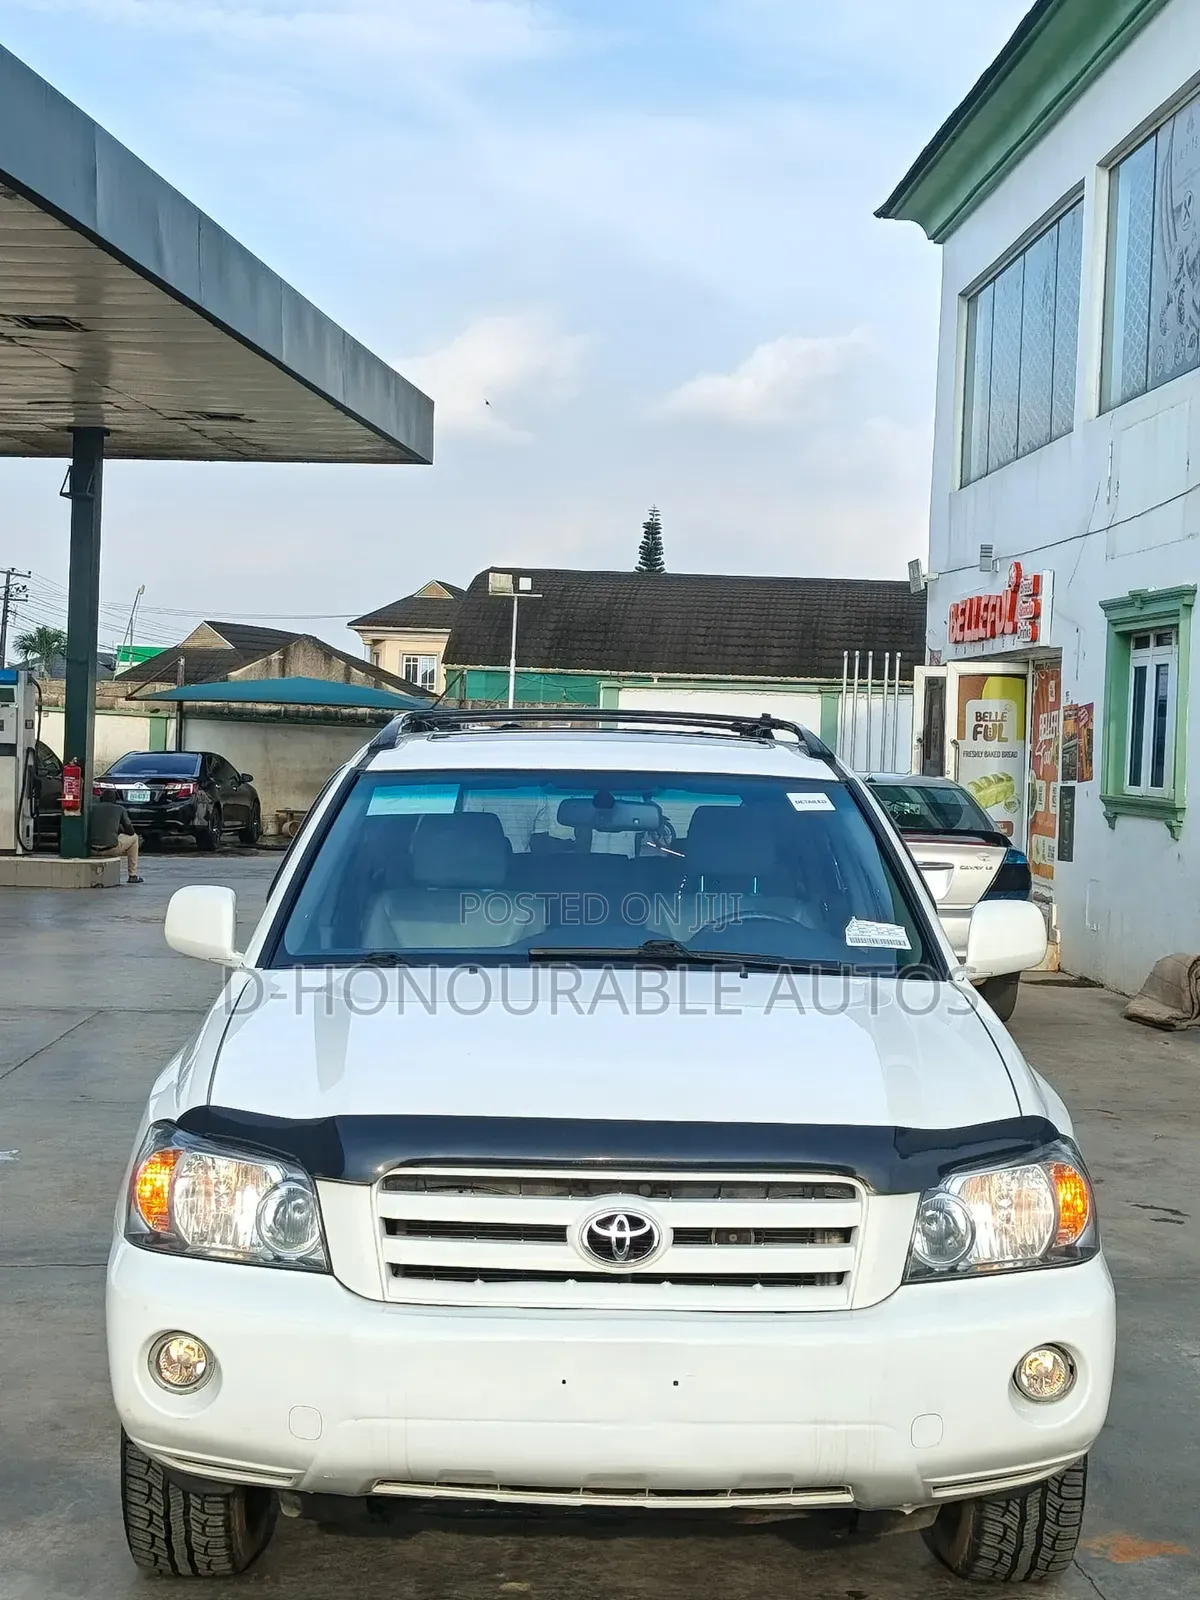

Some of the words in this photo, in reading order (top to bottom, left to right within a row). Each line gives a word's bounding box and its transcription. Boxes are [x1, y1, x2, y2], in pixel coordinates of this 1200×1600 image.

[949, 589, 1017, 643] BELLEFUL
[975, 711, 1007, 722] BELLE
[972, 723, 1009, 742] FUL
[962, 750, 983, 758] FRESHLY
[984, 750, 1001, 758] BAKED
[1002, 750, 1018, 758] BREAD
